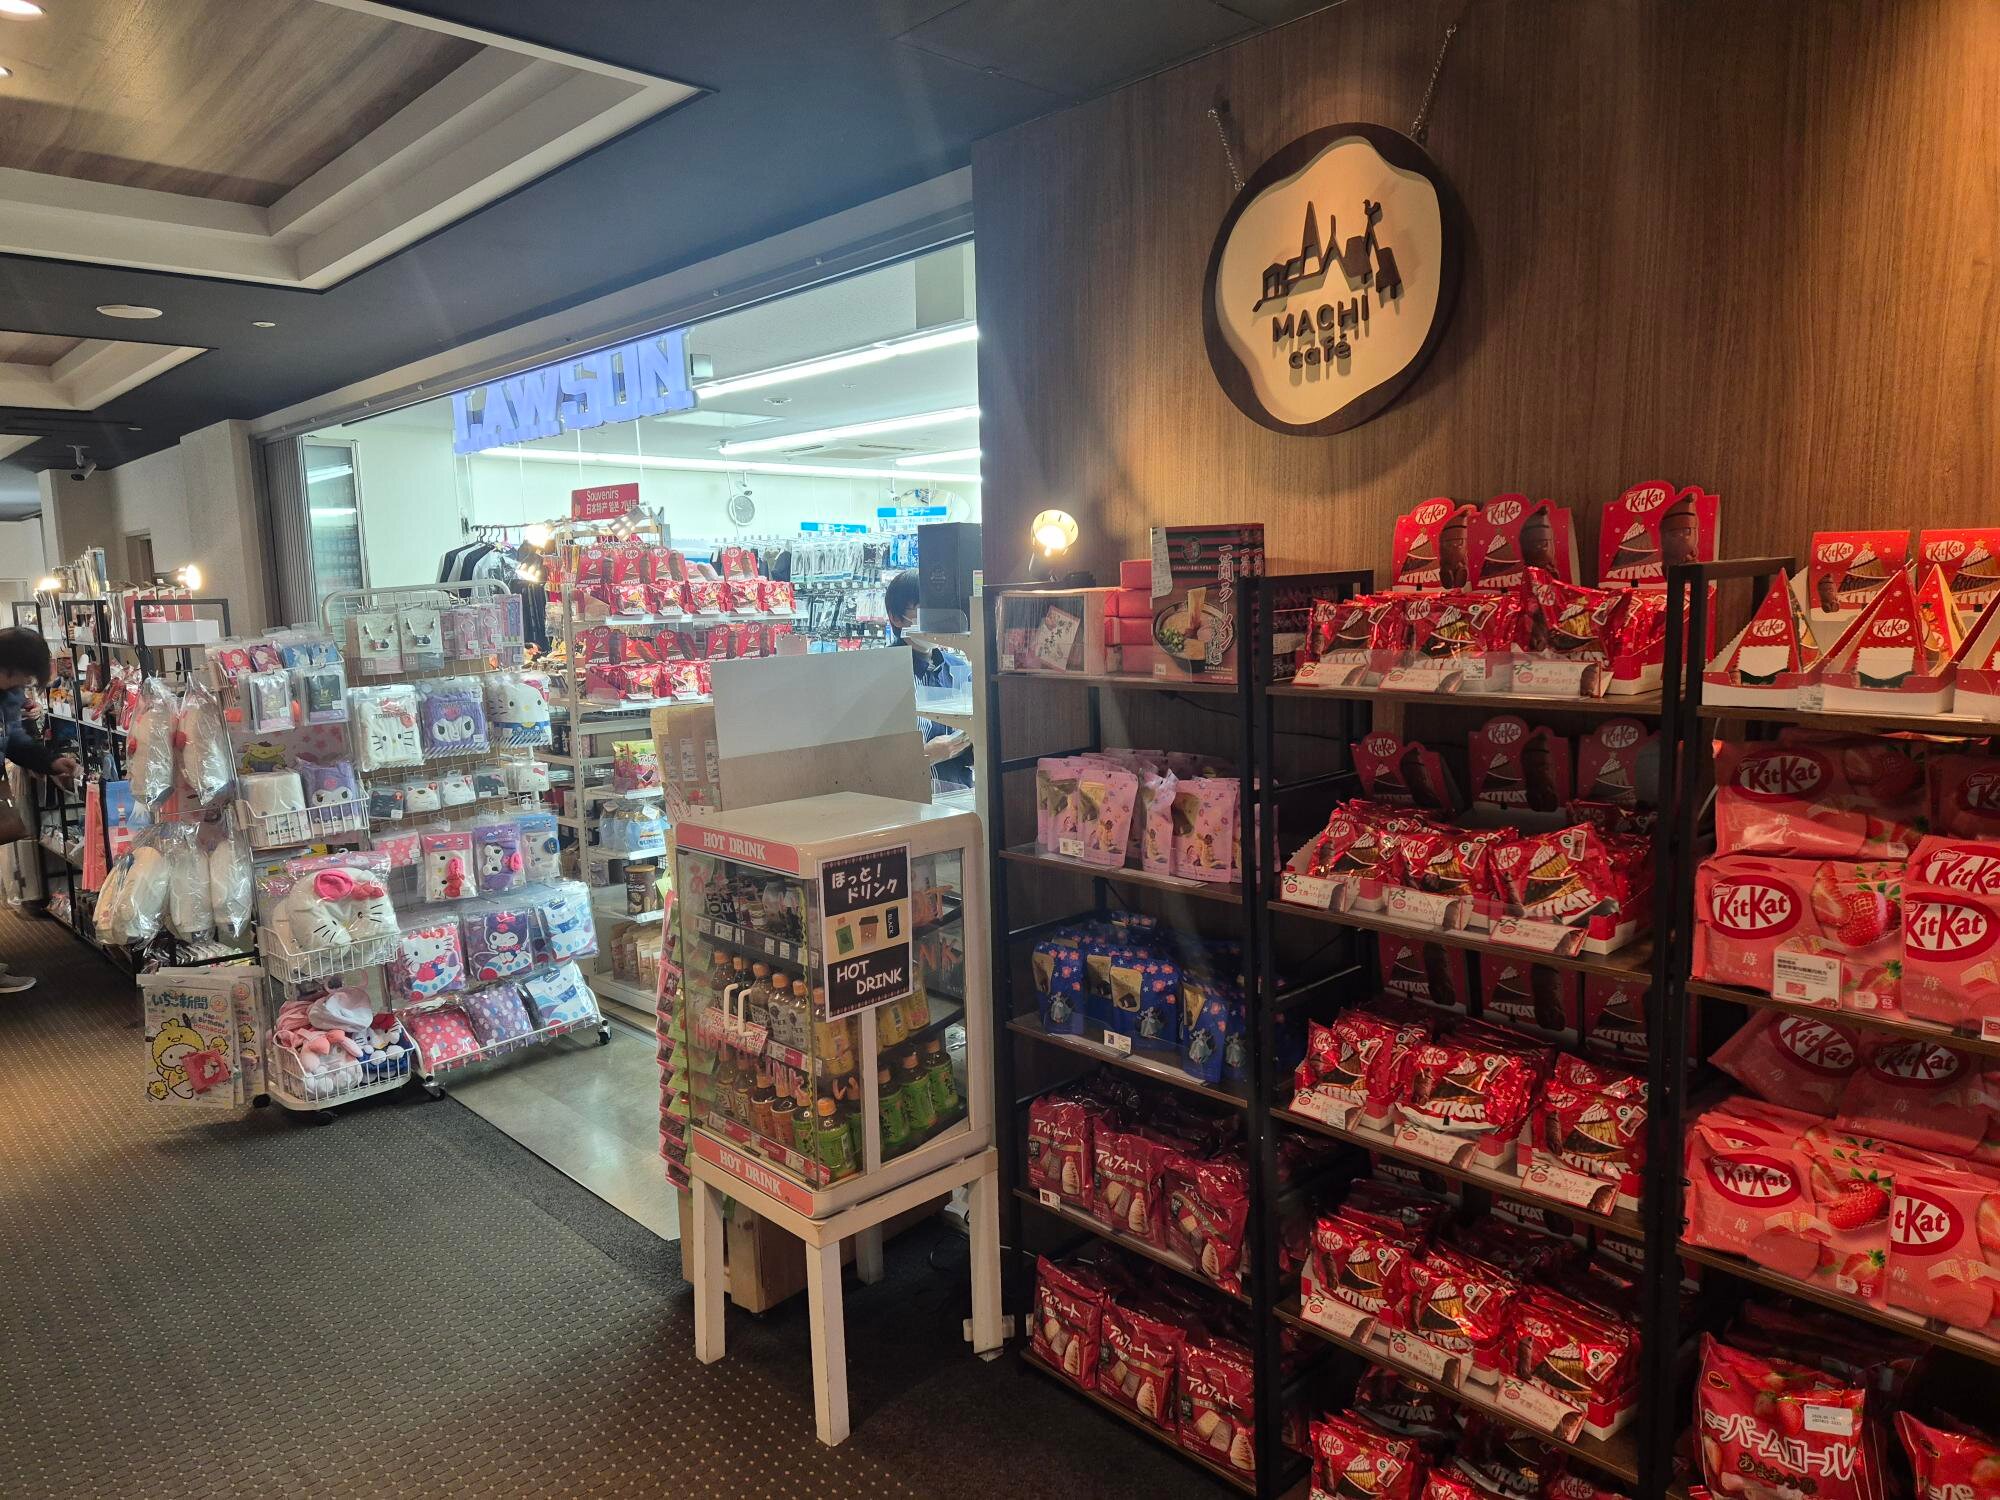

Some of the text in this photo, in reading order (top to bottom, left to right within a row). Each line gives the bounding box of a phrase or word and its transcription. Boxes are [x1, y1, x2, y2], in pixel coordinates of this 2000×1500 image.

[1272, 294, 1369, 342] MACHI
[1288, 333, 1352, 370] café
[452, 328, 697, 455] LAWSON
[586, 488, 619, 501] Souvenirs
[1626, 488, 1666, 512] KitKat
[1416, 503, 1448, 525] KitKat
[1488, 501, 1522, 525] KitKat
[1819, 542, 1854, 562] KitKat
[1927, 541, 1966, 562] KitKat
[1477, 571, 1523, 587] KITKA
[1605, 562, 1664, 580] KITKAT
[1837, 591, 1877, 604] KITK
[1952, 590, 1990, 604] KITK
[1752, 618, 1786, 637] KitKat
[1874, 619, 1909, 637] KitKat
[1488, 723, 1522, 744] KitKat
[1601, 725, 1639, 748] KitKat
[1368, 737, 1397, 757] KitKat
[1745, 756, 1821, 793] KitKat
[1479, 790, 1528, 803] KITKAT
[703, 831, 766, 861] HOT DRINK
[831, 863, 882, 890] ほっと！
[848, 878, 898, 904] ドリンク
[1718, 885, 1790, 929] KitKat
[1906, 903, 1983, 949] KitKat
[836, 960, 870, 983] HOT
[856, 968, 902, 996] DRINK
[1388, 980, 1429, 995] KITKAT
[151, 990, 209, 1010] いちご新聞
[1489, 1001, 1535, 1017] KITKAT
[1592, 1027, 1647, 1046] KITKAT
[1782, 1015, 1854, 1067] KitKat
[1878, 1041, 1959, 1079] KitKat
[1034, 1118, 1072, 1138] アルフォート
[719, 1149, 782, 1196] HOT DRINK
[1095, 1149, 1144, 1174] アルフォート
[1718, 1164, 1791, 1196] KitKat
[1893, 1198, 1948, 1243] tKat
[1317, 1230, 1343, 1250] KitKat
[1040, 1286, 1081, 1318] アルフォート
[1110, 1324, 1156, 1359] アルフォート
[1186, 1374, 1243, 1411] アルフォート
[1318, 1432, 1344, 1455] KitKat
